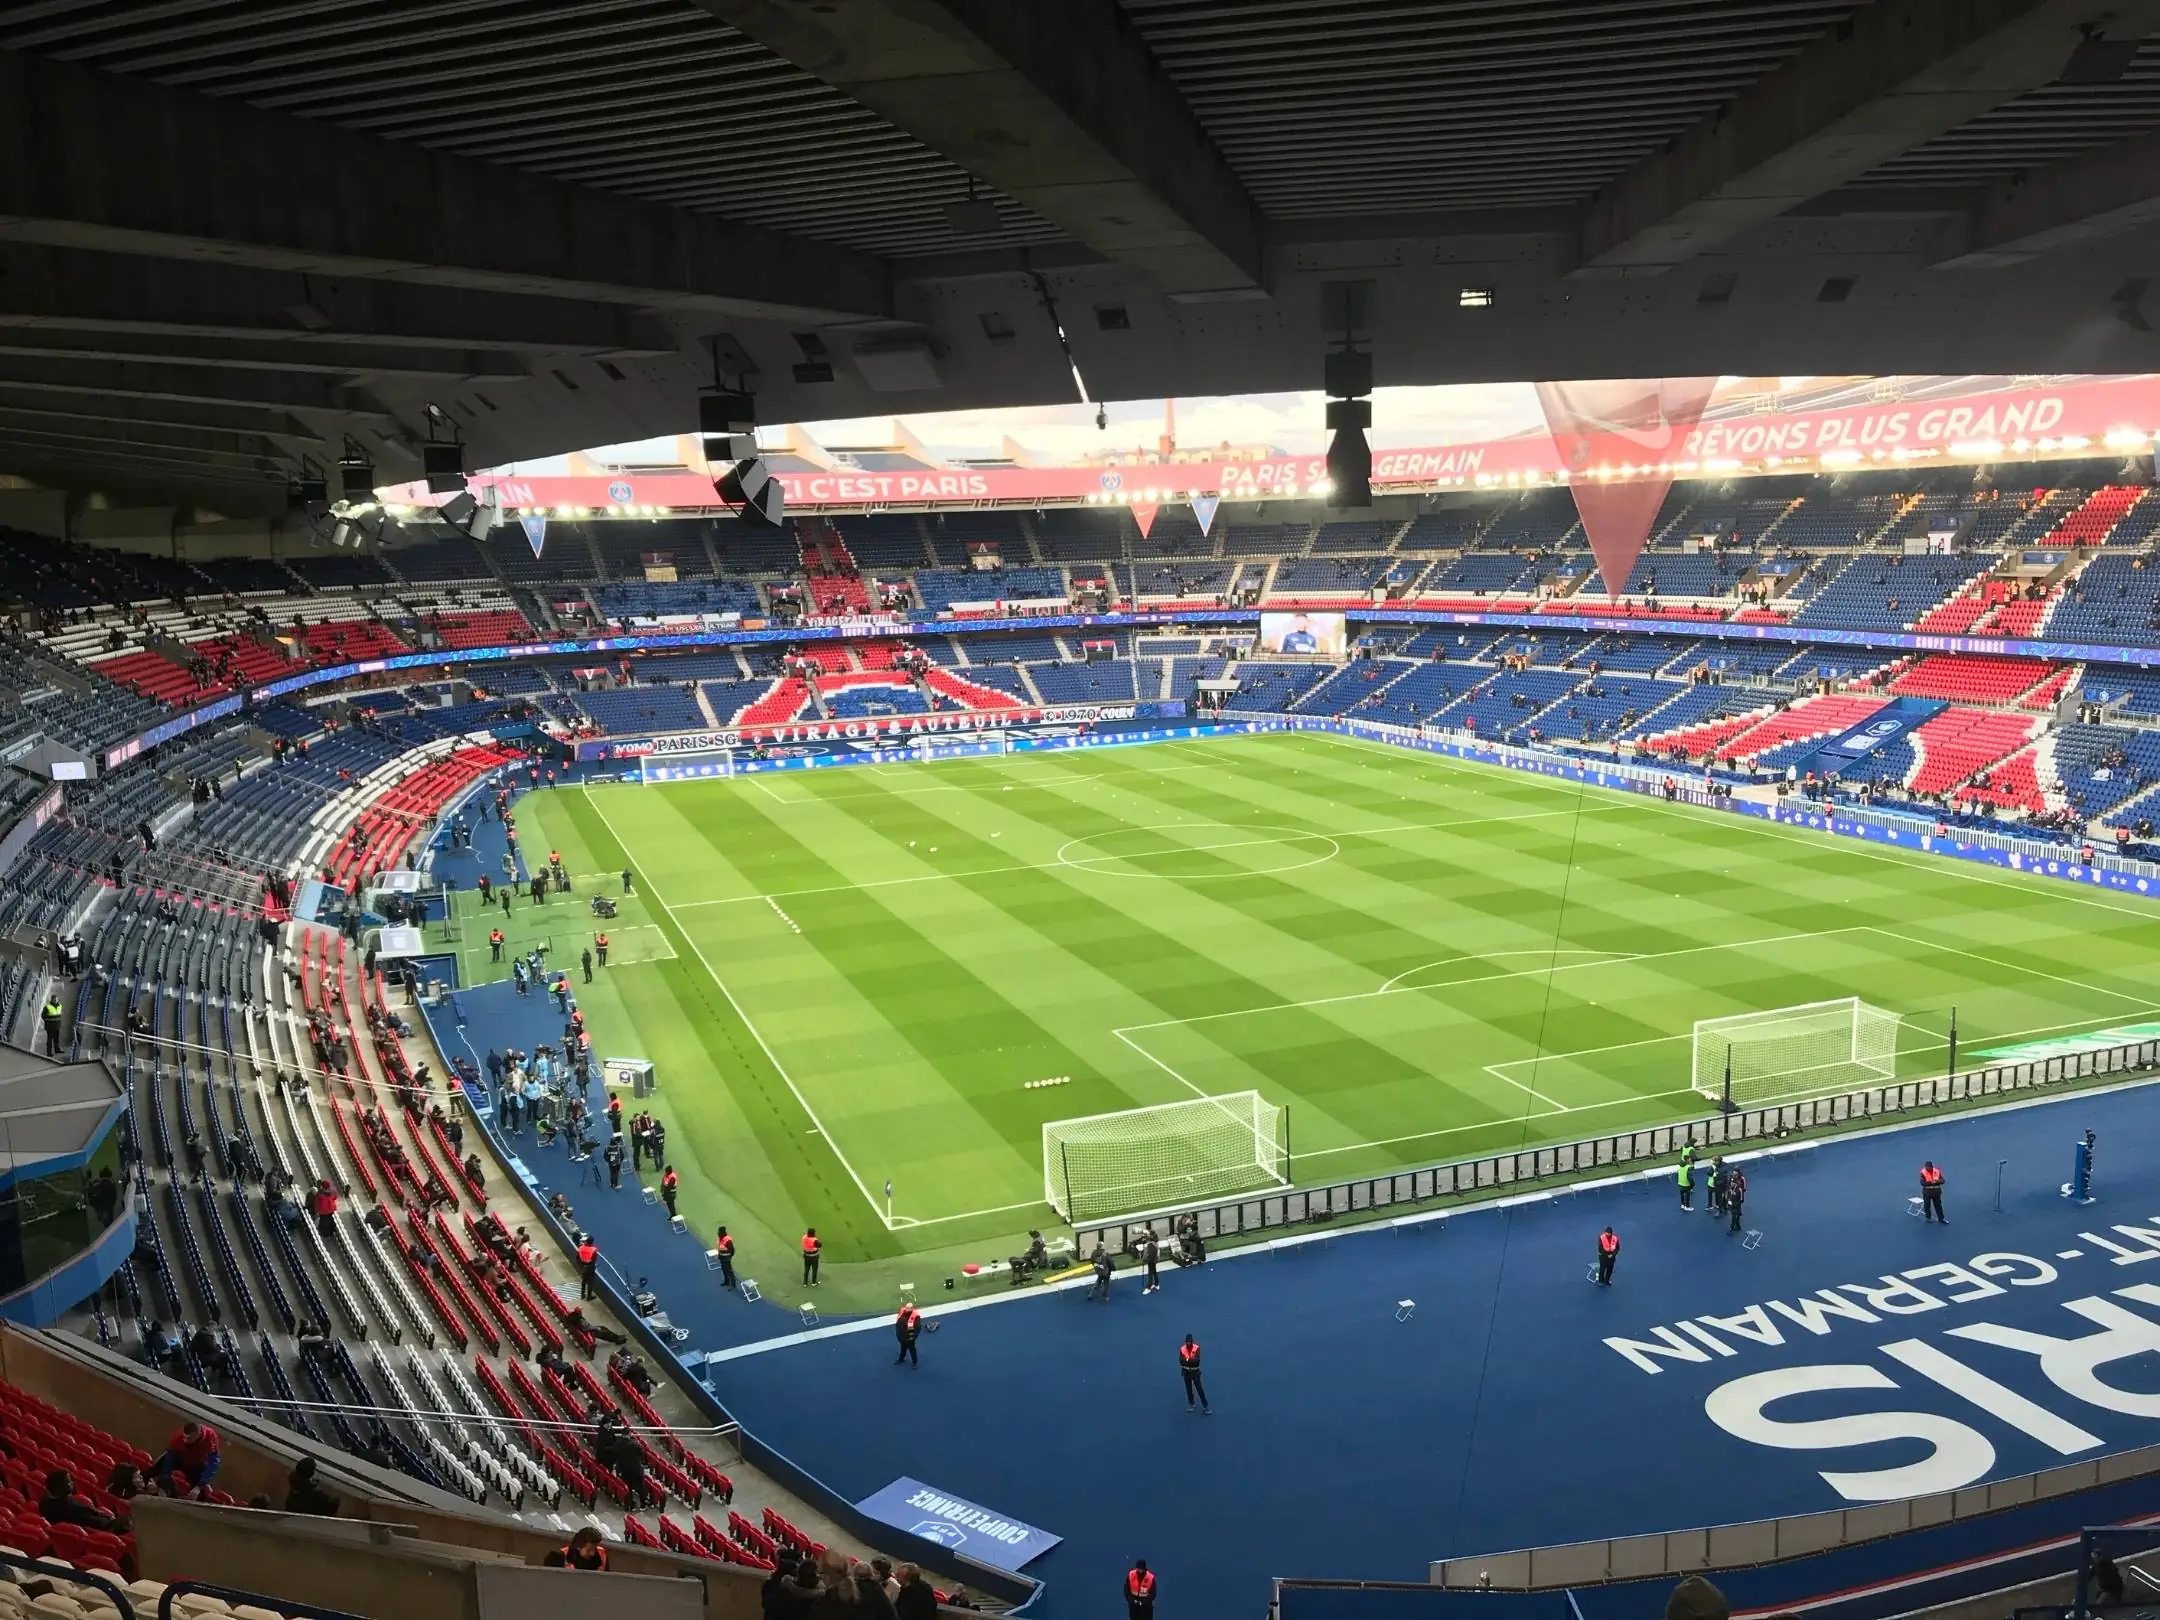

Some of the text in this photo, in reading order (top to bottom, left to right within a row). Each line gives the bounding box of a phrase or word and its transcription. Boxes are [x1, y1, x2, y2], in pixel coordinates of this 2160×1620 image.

[1815, 412, 1910, 448] PLUS
[1917, 398, 2064, 441] GRAND
[1221, 462, 1295, 485] PARIS
[809, 478, 894, 499] C'EST
[900, 475, 988, 496] PARIS
[1086, 580, 1096, 590] S
[565, 602, 576, 613] U
[1060, 709, 1097, 721] 1970
[772, 714, 1012, 743] VIRAGE AUTEUIL
[657, 733, 737, 751] PARIS SG
